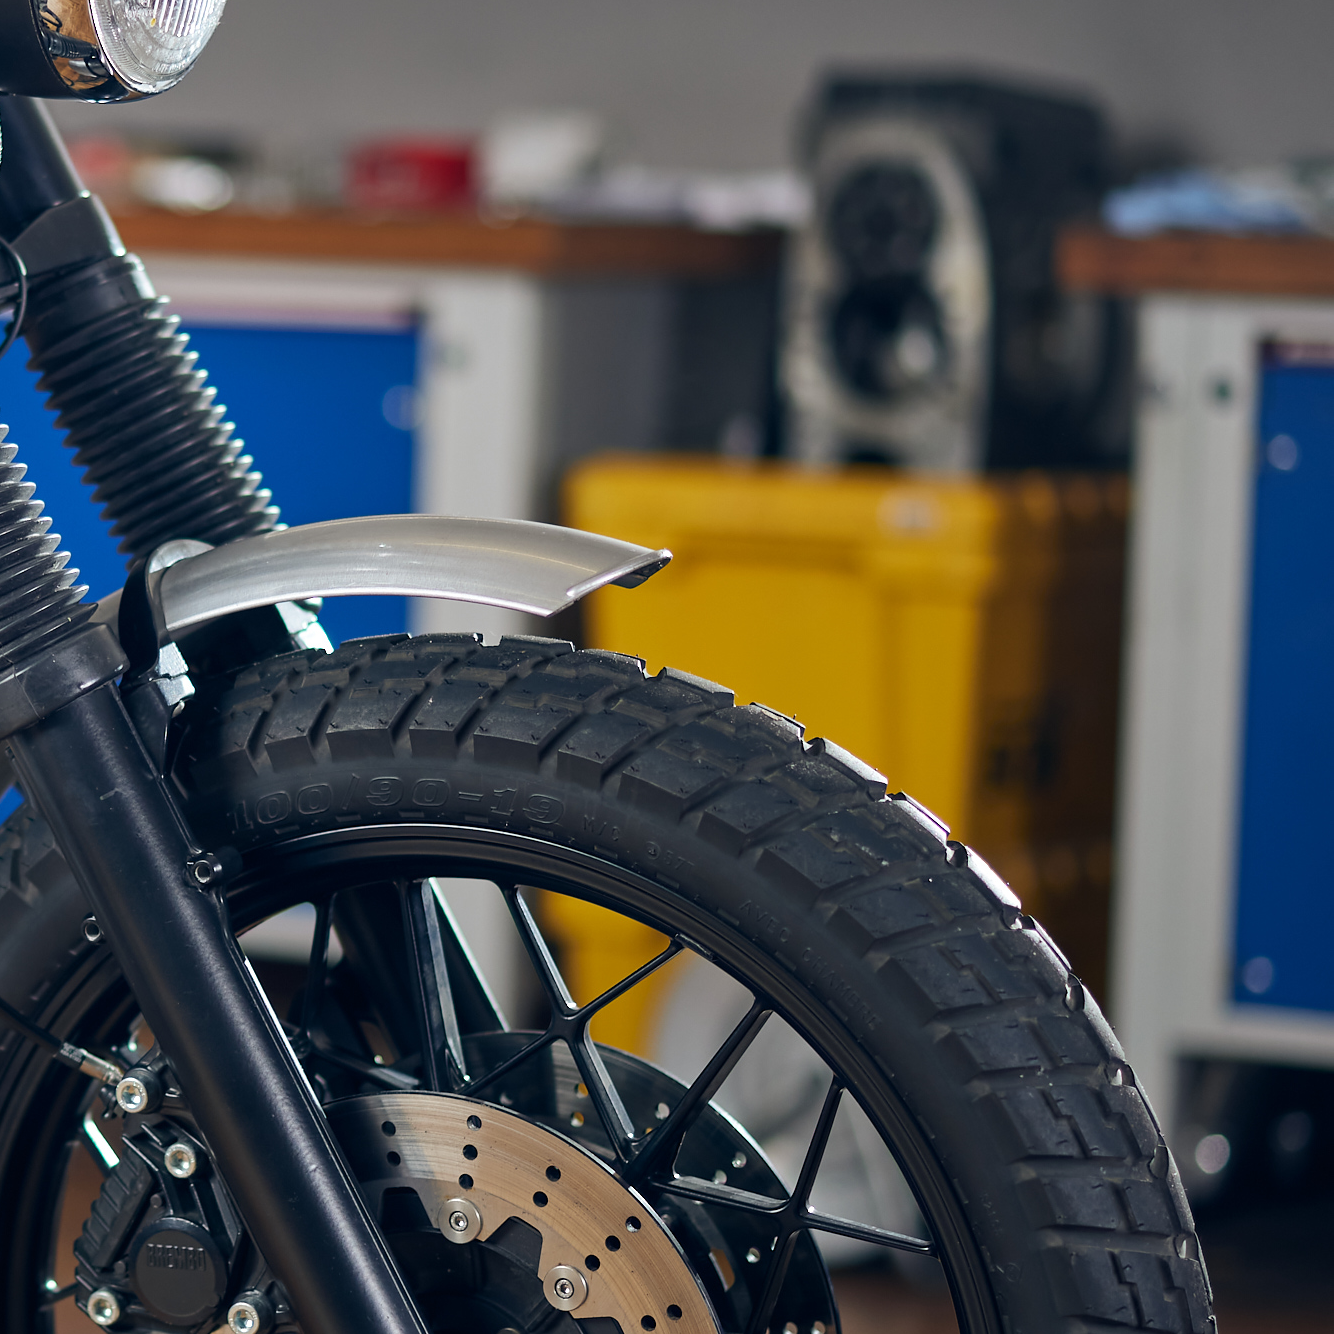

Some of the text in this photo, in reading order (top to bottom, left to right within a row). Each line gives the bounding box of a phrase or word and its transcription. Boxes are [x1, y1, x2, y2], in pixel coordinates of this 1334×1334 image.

[738, 898, 884, 1031] AVEC CHAMBRE
[147, 1243, 207, 1272] BREMBO
